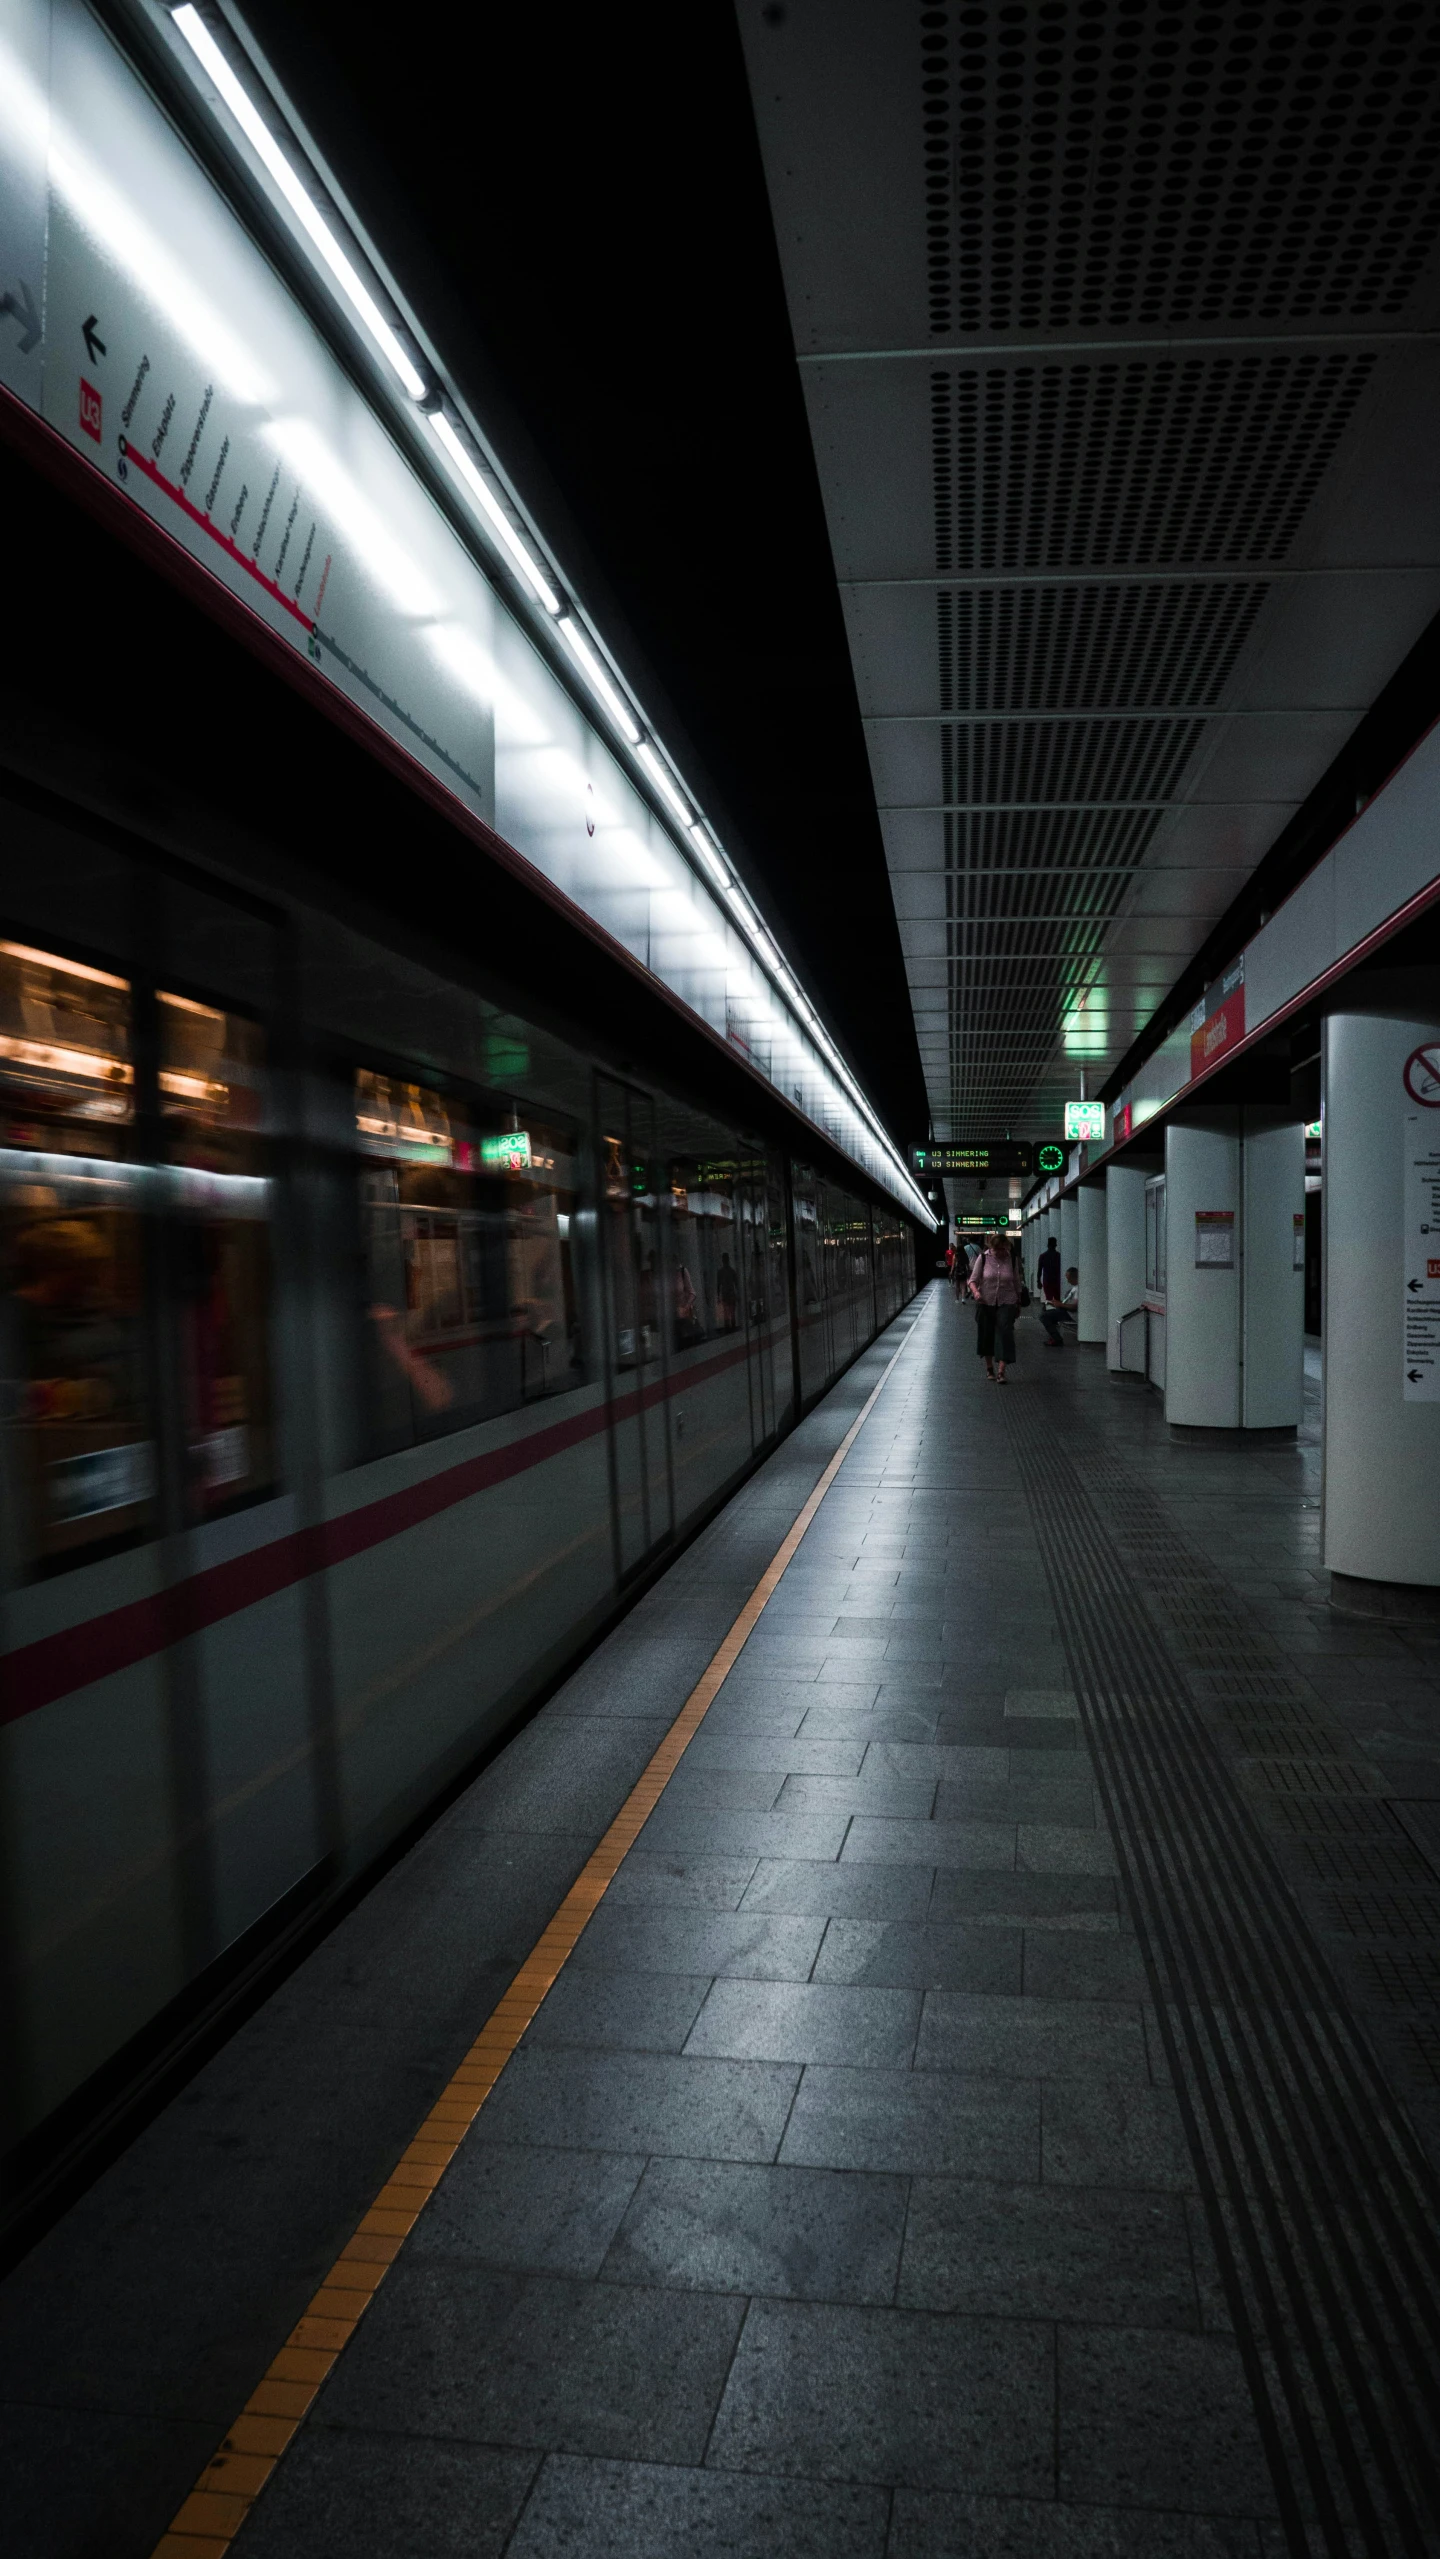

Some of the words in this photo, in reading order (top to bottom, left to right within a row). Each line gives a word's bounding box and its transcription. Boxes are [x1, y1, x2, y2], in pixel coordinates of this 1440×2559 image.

[81, 389, 101, 431] U3
[1070, 1104, 1101, 1119] SOS
[918, 1158, 924, 1168] 1
